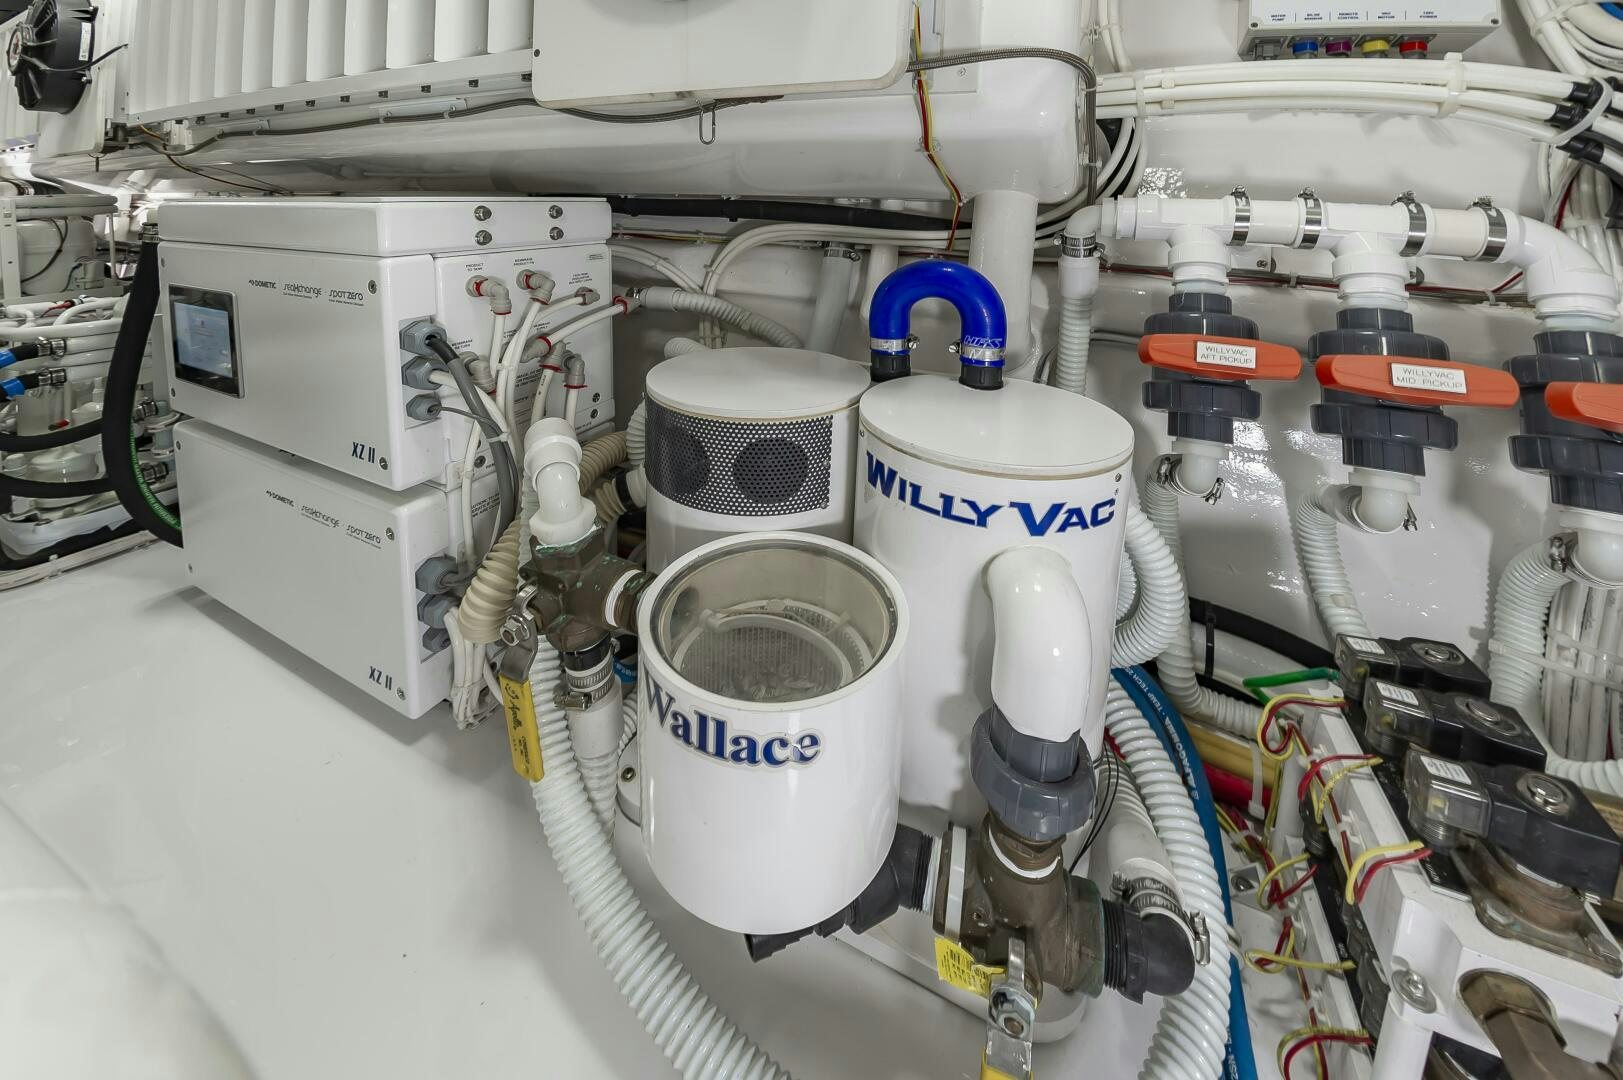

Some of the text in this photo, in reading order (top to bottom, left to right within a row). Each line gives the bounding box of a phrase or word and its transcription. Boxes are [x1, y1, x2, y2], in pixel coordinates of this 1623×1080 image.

[255, 280, 276, 289] DOMETIC
[1220, 355, 1252, 365] PICKUP
[1422, 379, 1462, 389] PICKUP
[352, 442, 365, 460] XZ
[866, 450, 1116, 537] WILLY VAC
[369, 666, 382, 685] XZ
[1132, 674, 1148, 692] TECH
[1148, 692, 1163, 712] TEMP
[643, 661, 820, 768] Wallace
